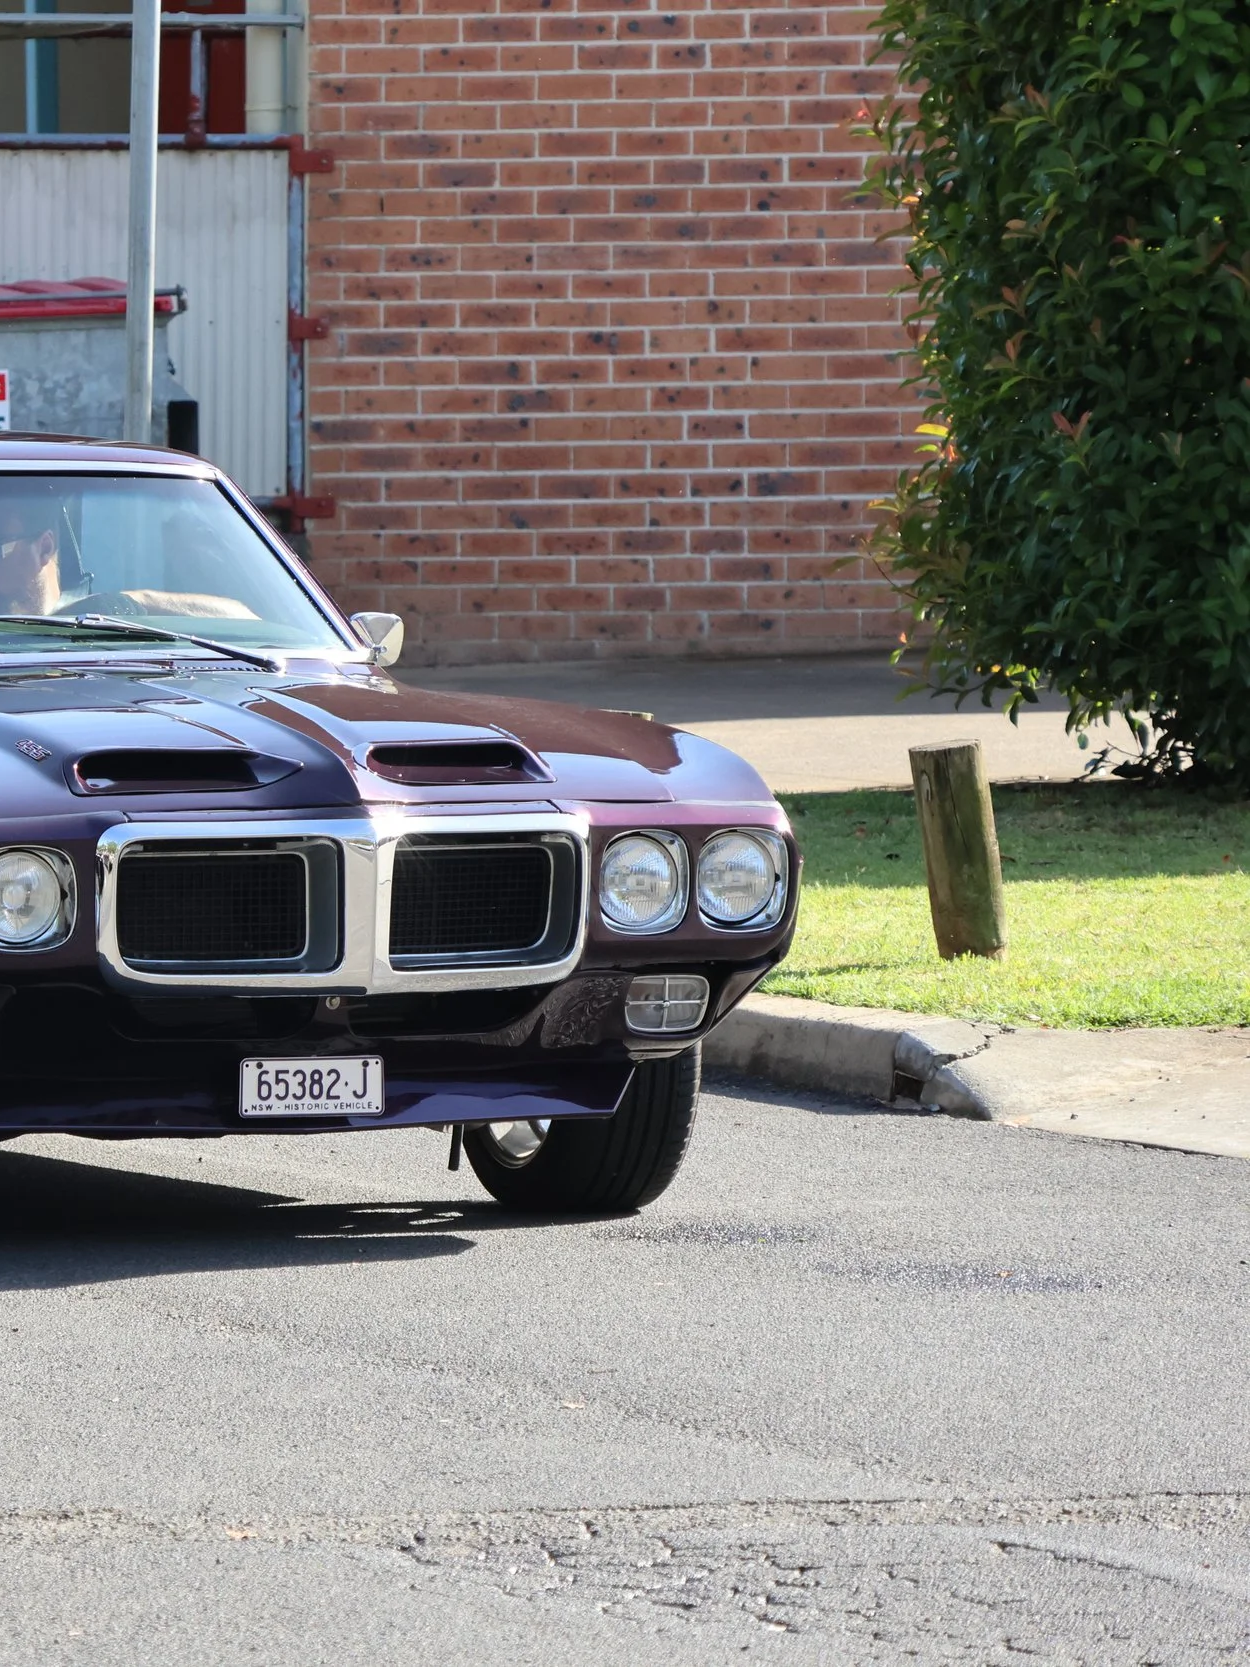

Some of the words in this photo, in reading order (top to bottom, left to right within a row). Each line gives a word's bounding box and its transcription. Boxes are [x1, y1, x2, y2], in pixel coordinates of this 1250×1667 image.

[251, 1103, 274, 1111] NSW
[284, 1102, 330, 1111] HISTORIC
[333, 1101, 373, 1110] VEHICLE
